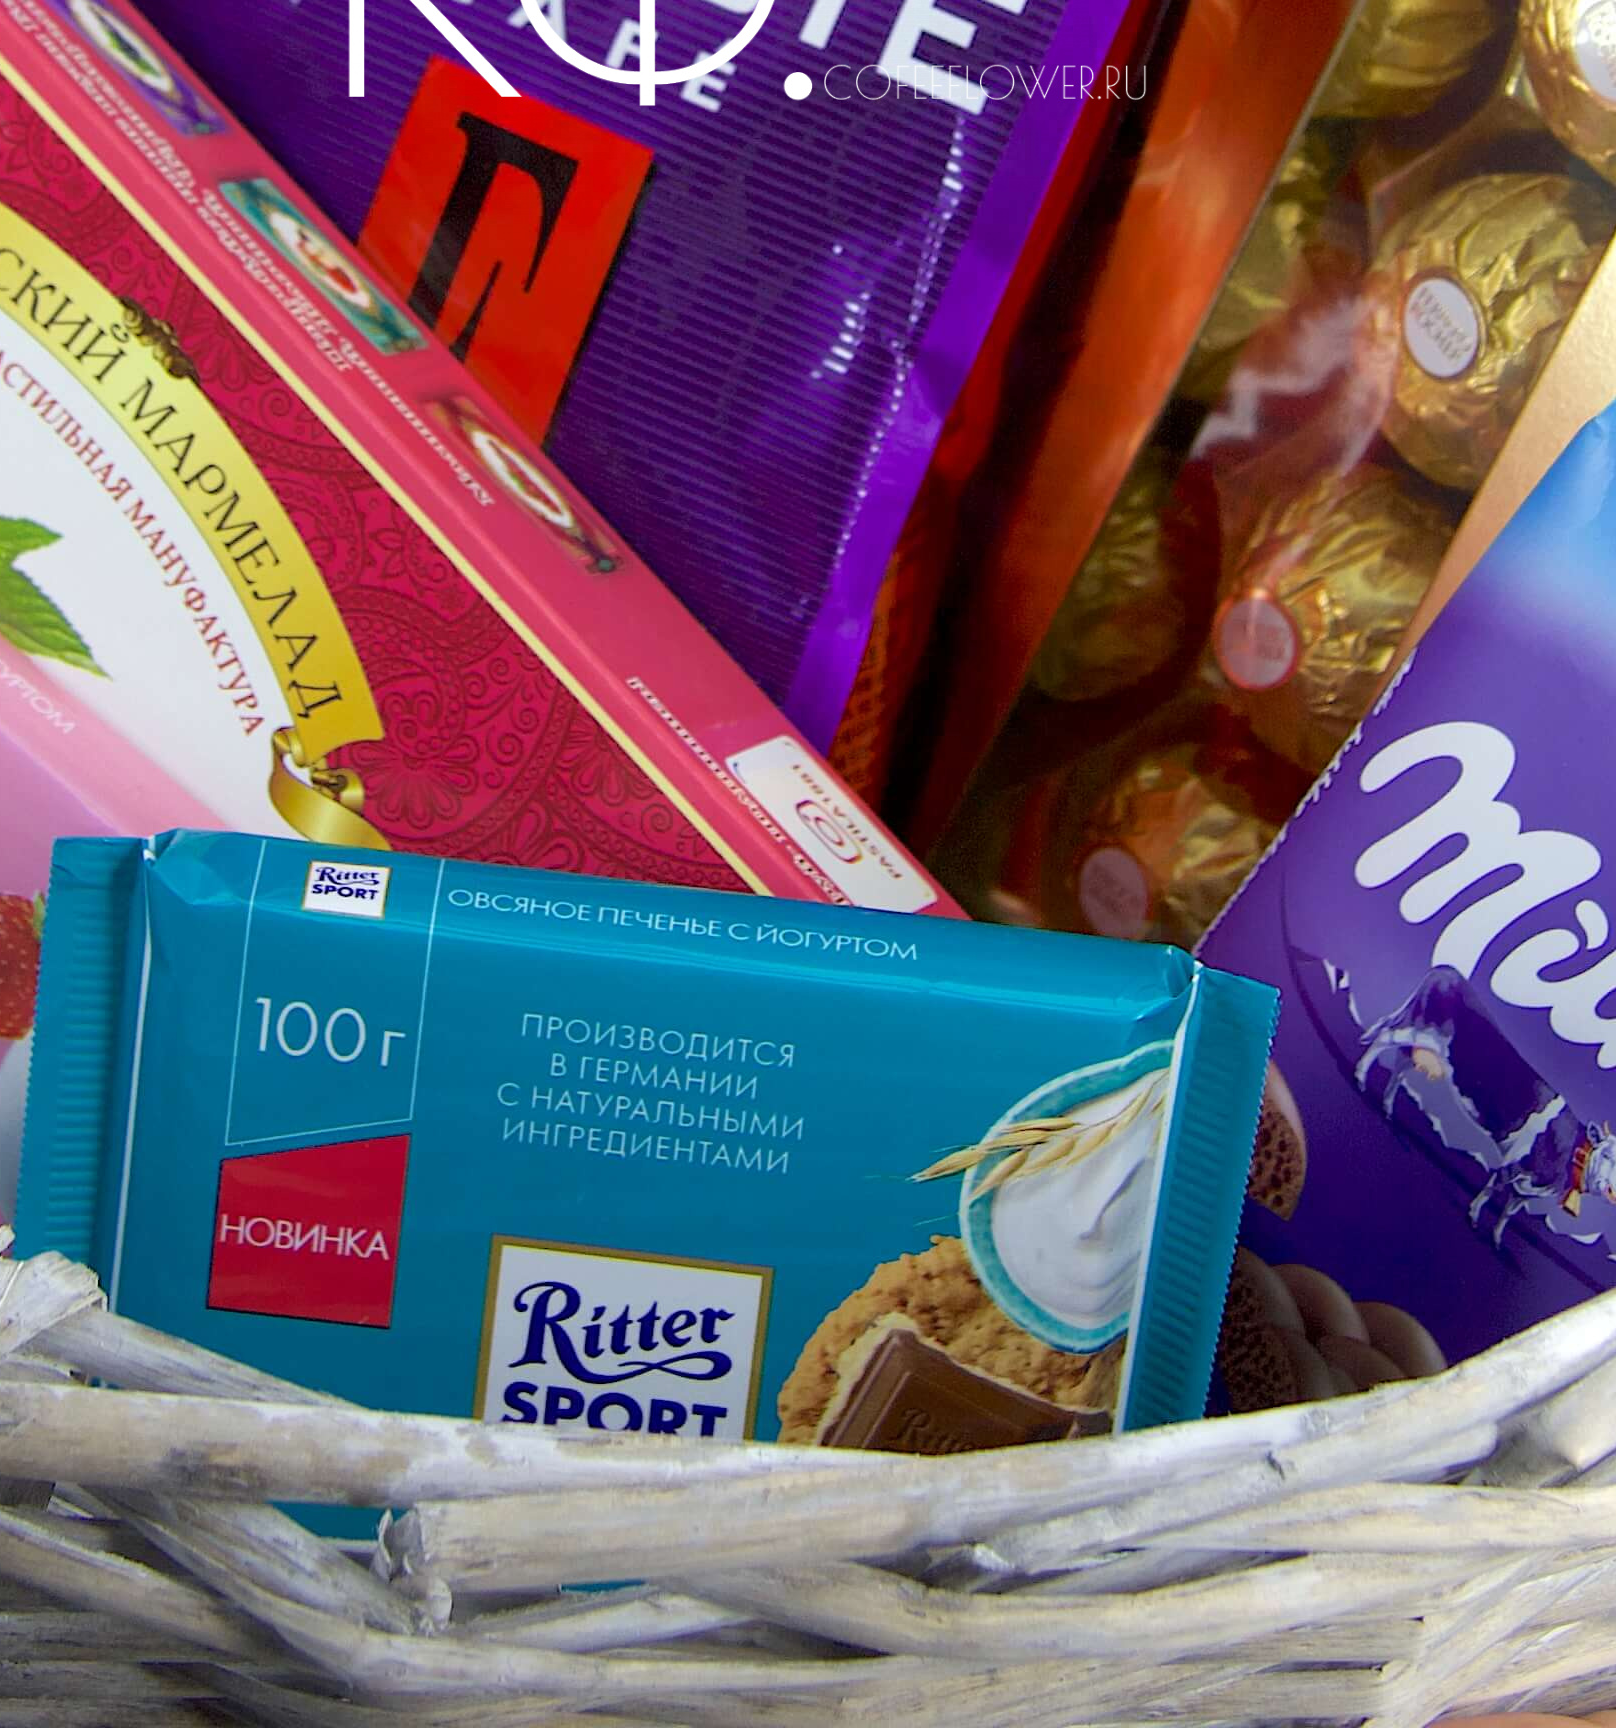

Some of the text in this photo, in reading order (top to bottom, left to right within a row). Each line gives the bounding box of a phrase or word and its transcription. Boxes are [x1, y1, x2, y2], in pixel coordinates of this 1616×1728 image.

[118, 375, 344, 720] МАРМЕЛАД
[123, 497, 267, 737] МАНУФАКТУРА
[311, 882, 379, 901] SPORT
[315, 865, 381, 887] Ritter
[447, 887, 919, 962] ОВСЯНОЕ ПЕЧЕНЬЕ С ЙОГУРТОМ
[255, 996, 407, 1068] 100 г
[520, 1012, 796, 1069] ПРОИЗВОДИТСЯ
[550, 1052, 759, 1100] В ГЕРМАНИИ
[496, 1081, 806, 1141] С НАТУРАЛЬНЫМИ
[502, 1116, 790, 1174] ИНГРЕДИЕНТАМИ
[219, 1213, 390, 1261] НОВИНКА
[508, 1280, 737, 1385] Ritter
